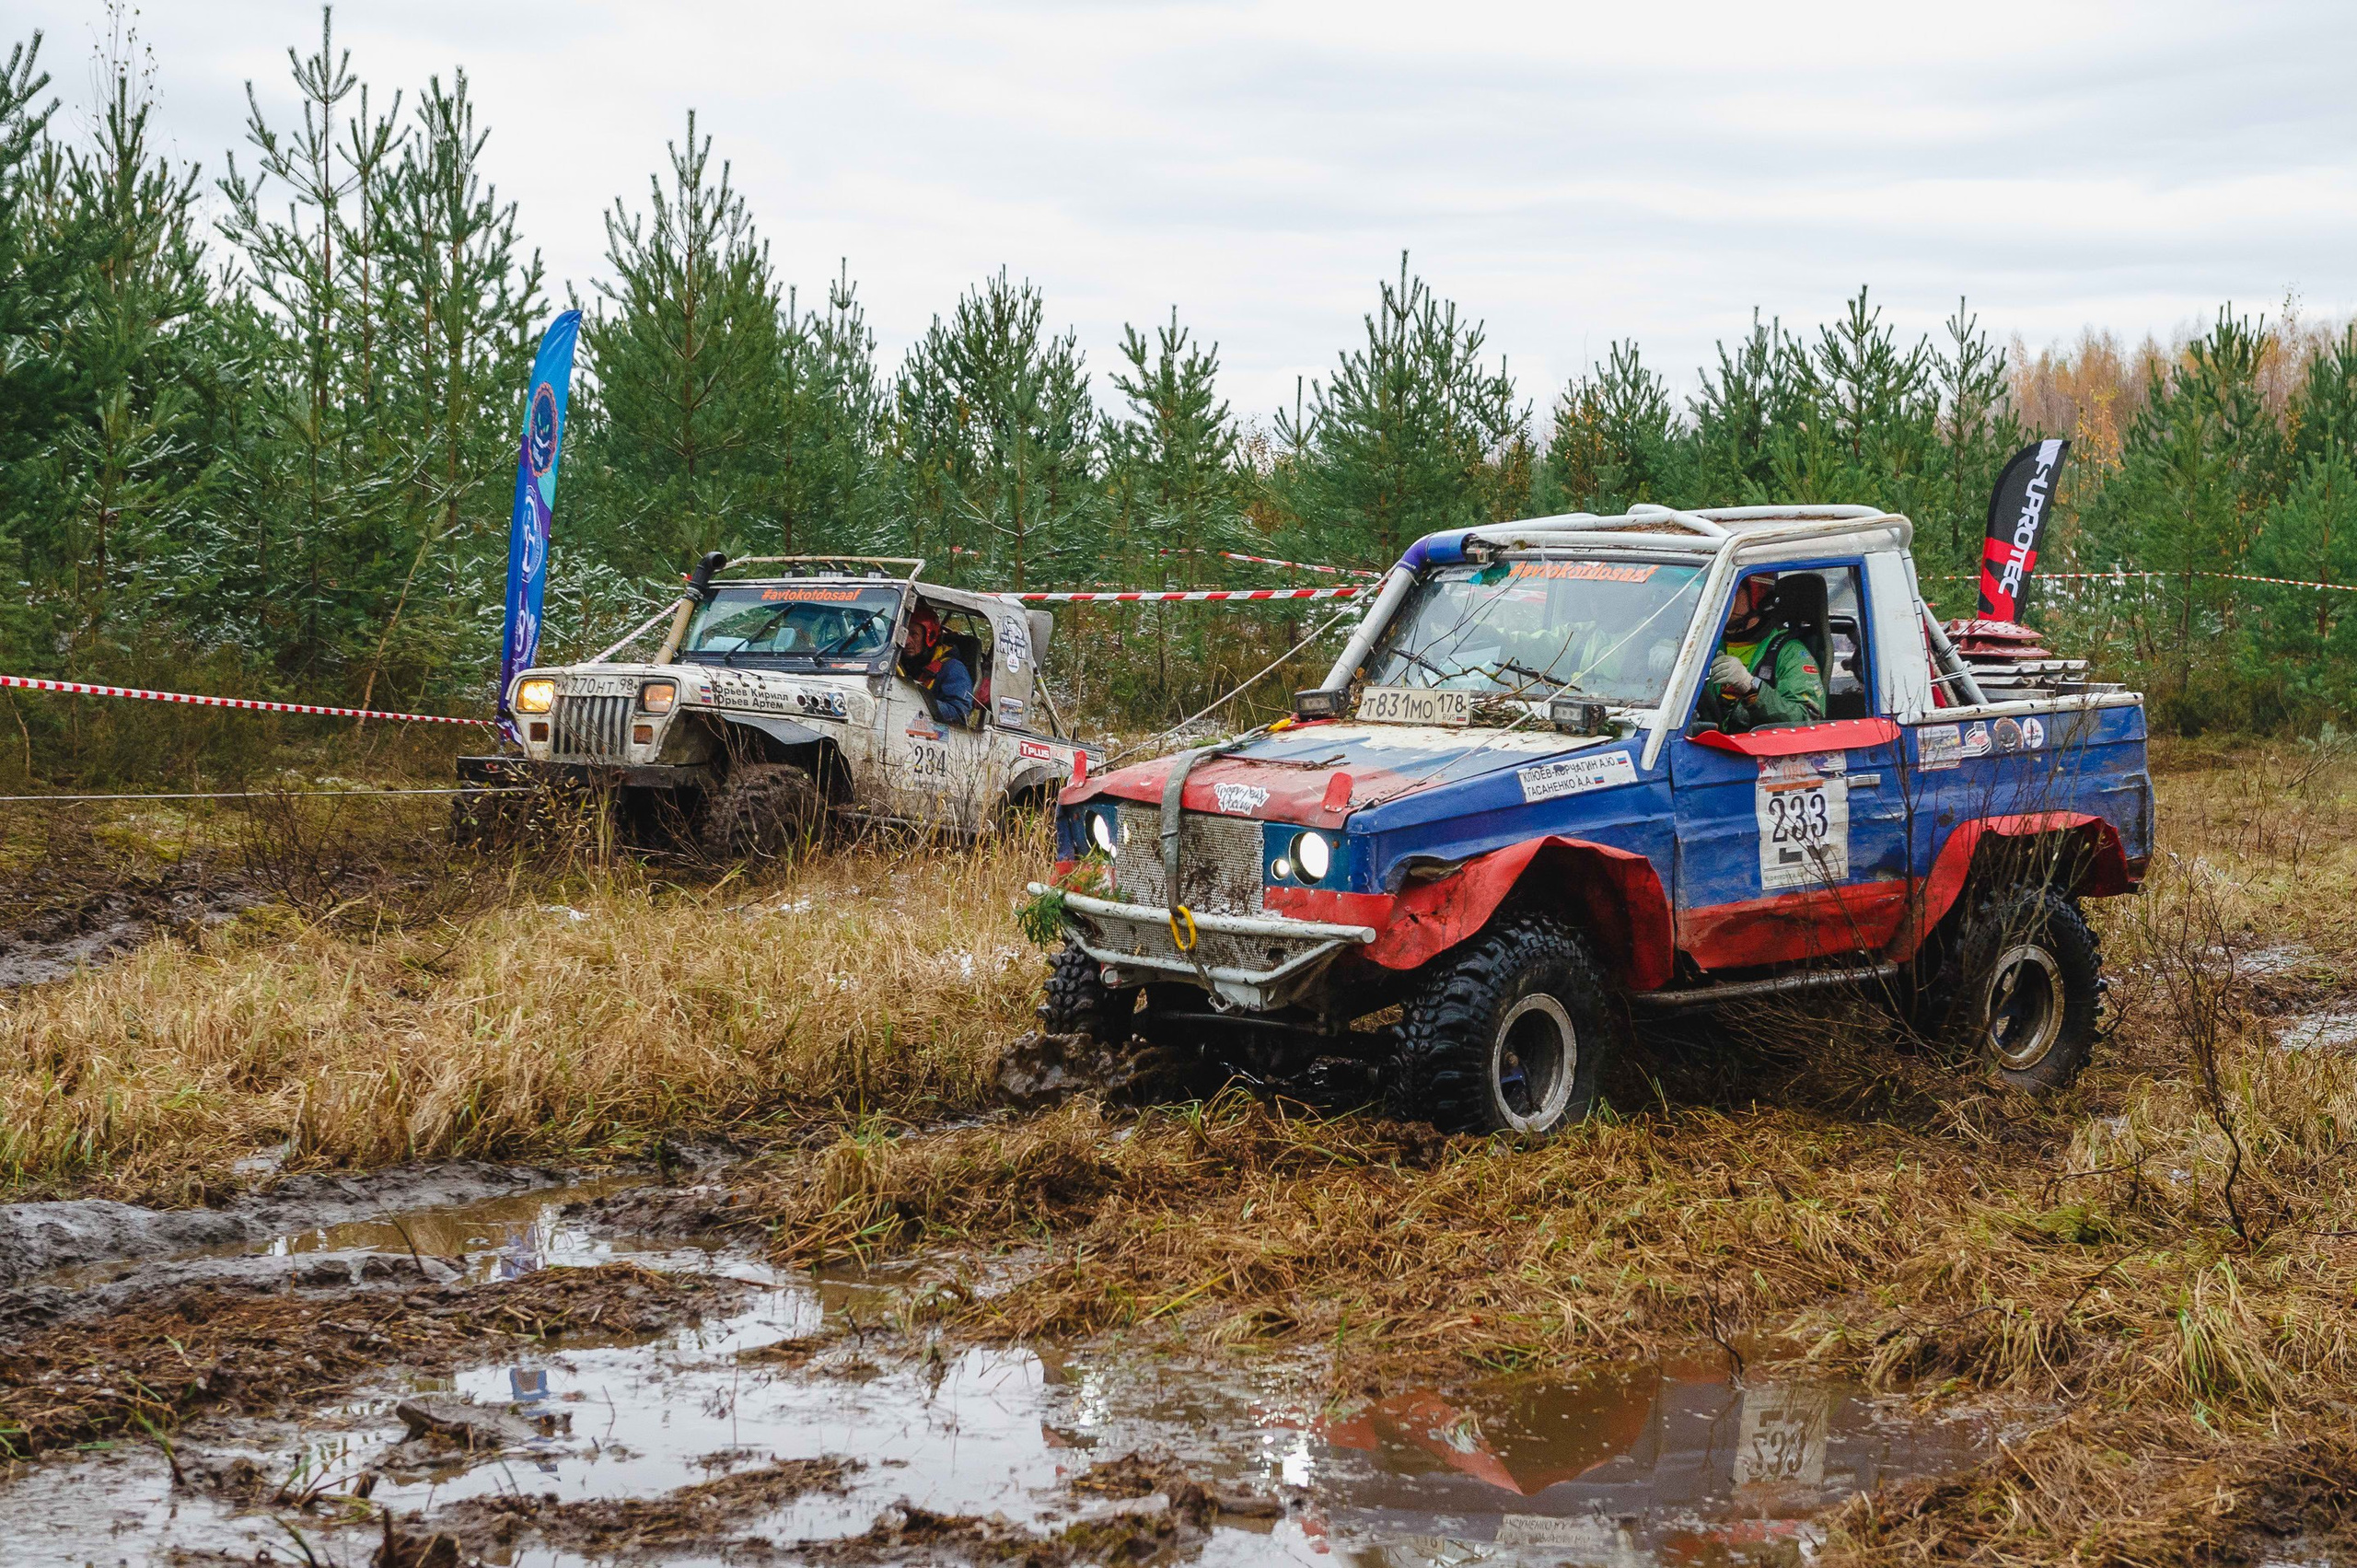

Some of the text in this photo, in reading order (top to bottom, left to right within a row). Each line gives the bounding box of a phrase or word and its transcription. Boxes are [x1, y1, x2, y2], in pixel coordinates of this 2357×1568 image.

[1998, 459, 2053, 598] SUPROTEC
[761, 587, 863, 602] #avtokotdosaaf
[620, 678, 633, 691] 98
[712, 684, 789, 702] Юрьев Кирилл
[713, 693, 784, 710] Юрьев Артем
[1437, 693, 1464, 714] 178
[1442, 713, 1456, 721] RUS
[1021, 742, 1050, 759] TPLUS
[914, 745, 946, 777] 234
[1527, 779, 1576, 797] ГАСАНЕНКО
[1768, 793, 1829, 843] 233
